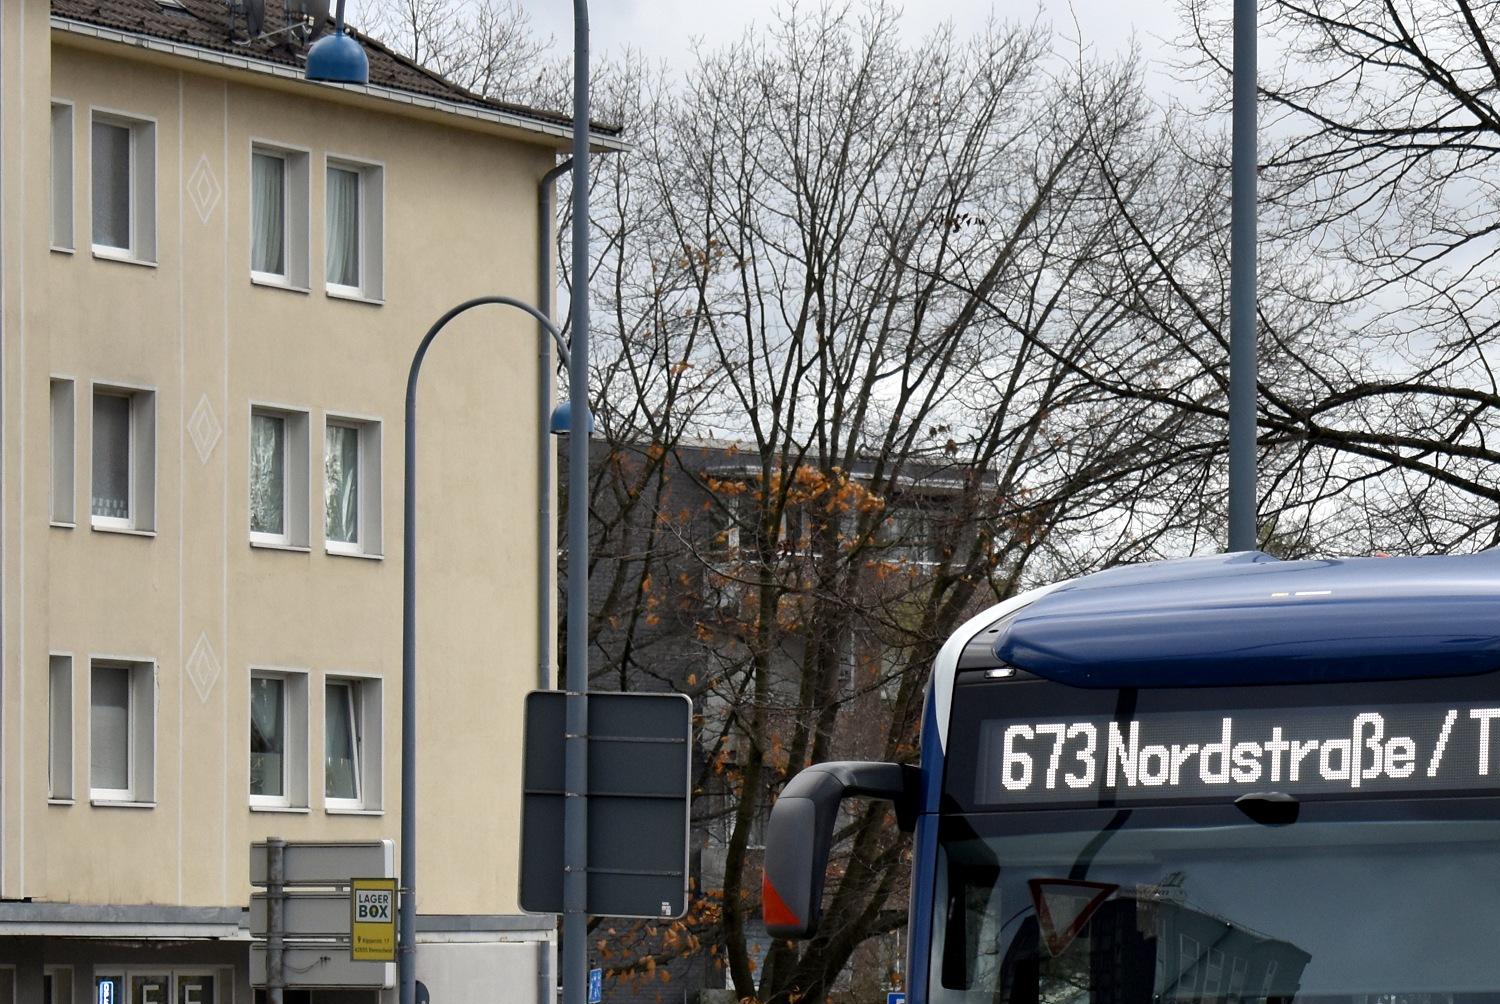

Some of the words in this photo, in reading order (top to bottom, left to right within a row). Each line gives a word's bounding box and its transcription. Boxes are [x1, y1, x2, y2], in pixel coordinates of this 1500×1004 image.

[1001, 722, 1097, 791] 673
[1105, 712, 1416, 788] Nordstraße
[1427, 708, 1458, 778] /
[358, 894, 389, 904] LAGER
[358, 904, 389, 919] BOX
